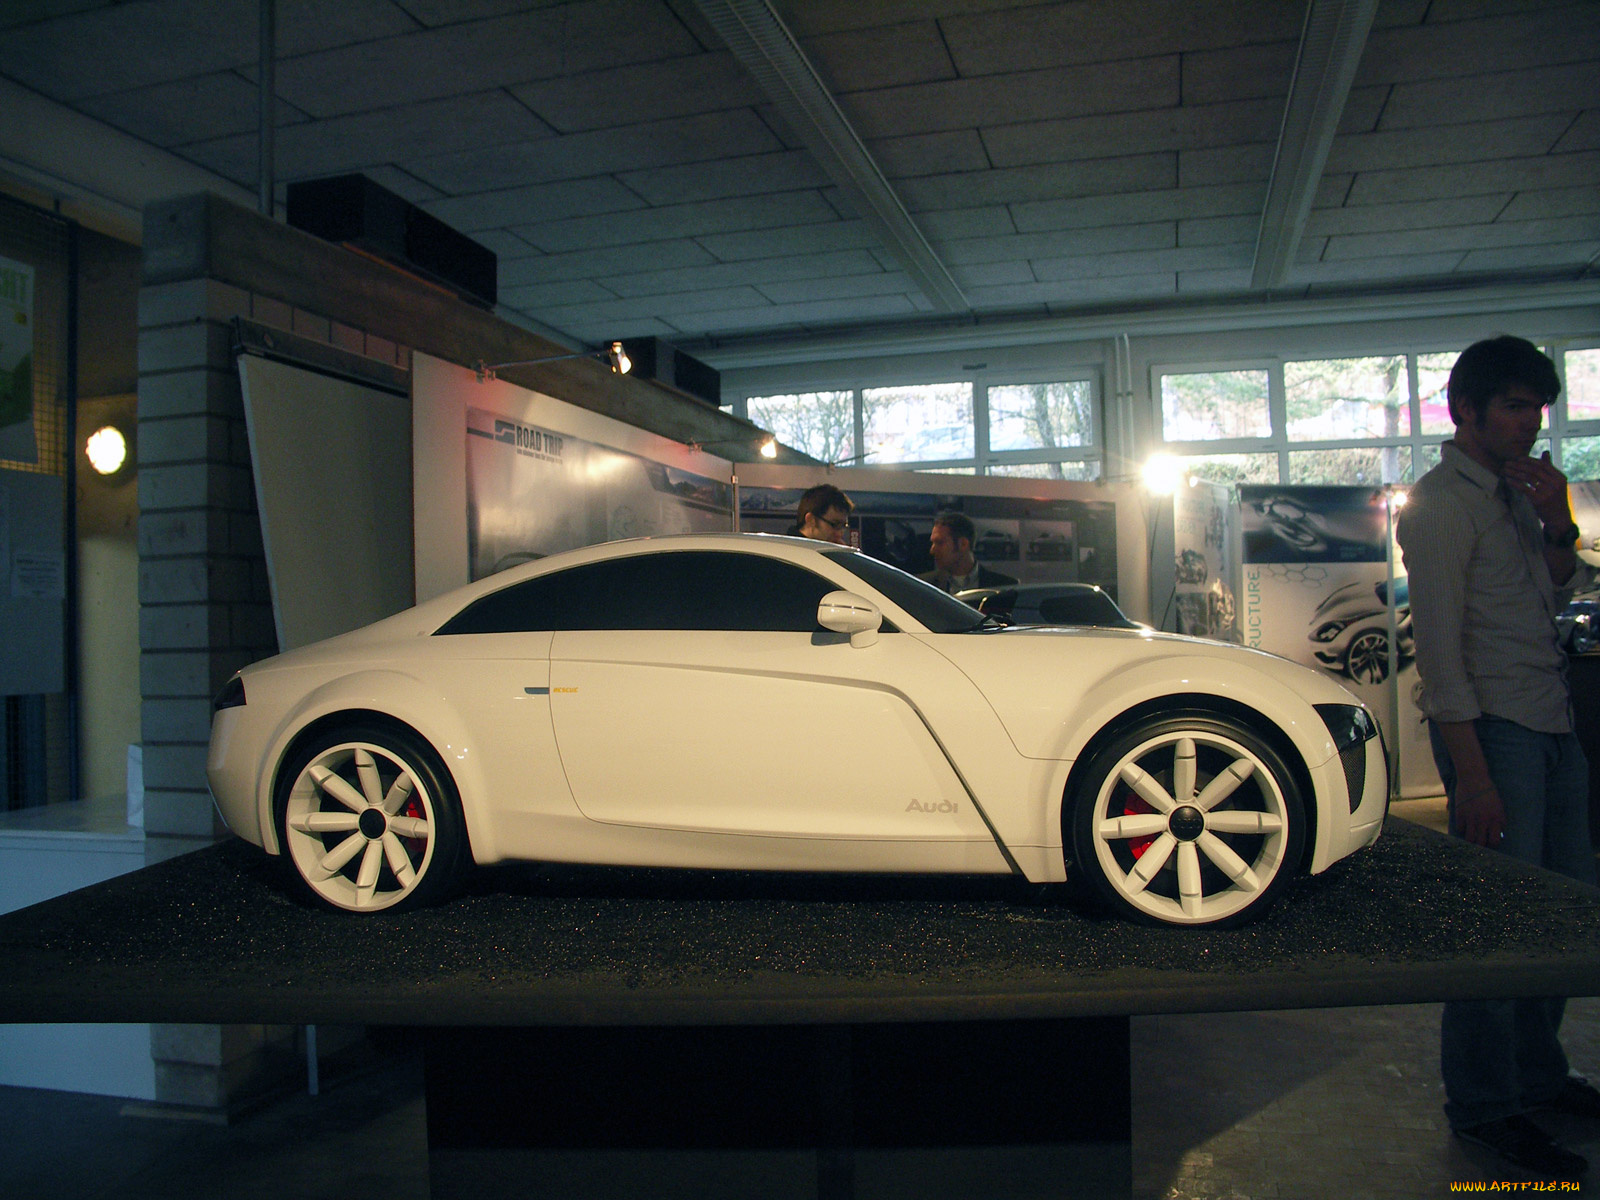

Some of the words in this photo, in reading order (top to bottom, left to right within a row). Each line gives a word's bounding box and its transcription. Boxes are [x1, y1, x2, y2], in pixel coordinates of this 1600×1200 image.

[516, 425, 541, 452] ROAD
[543, 433, 563, 456] TRIP
[905, 798, 959, 814] Audi
